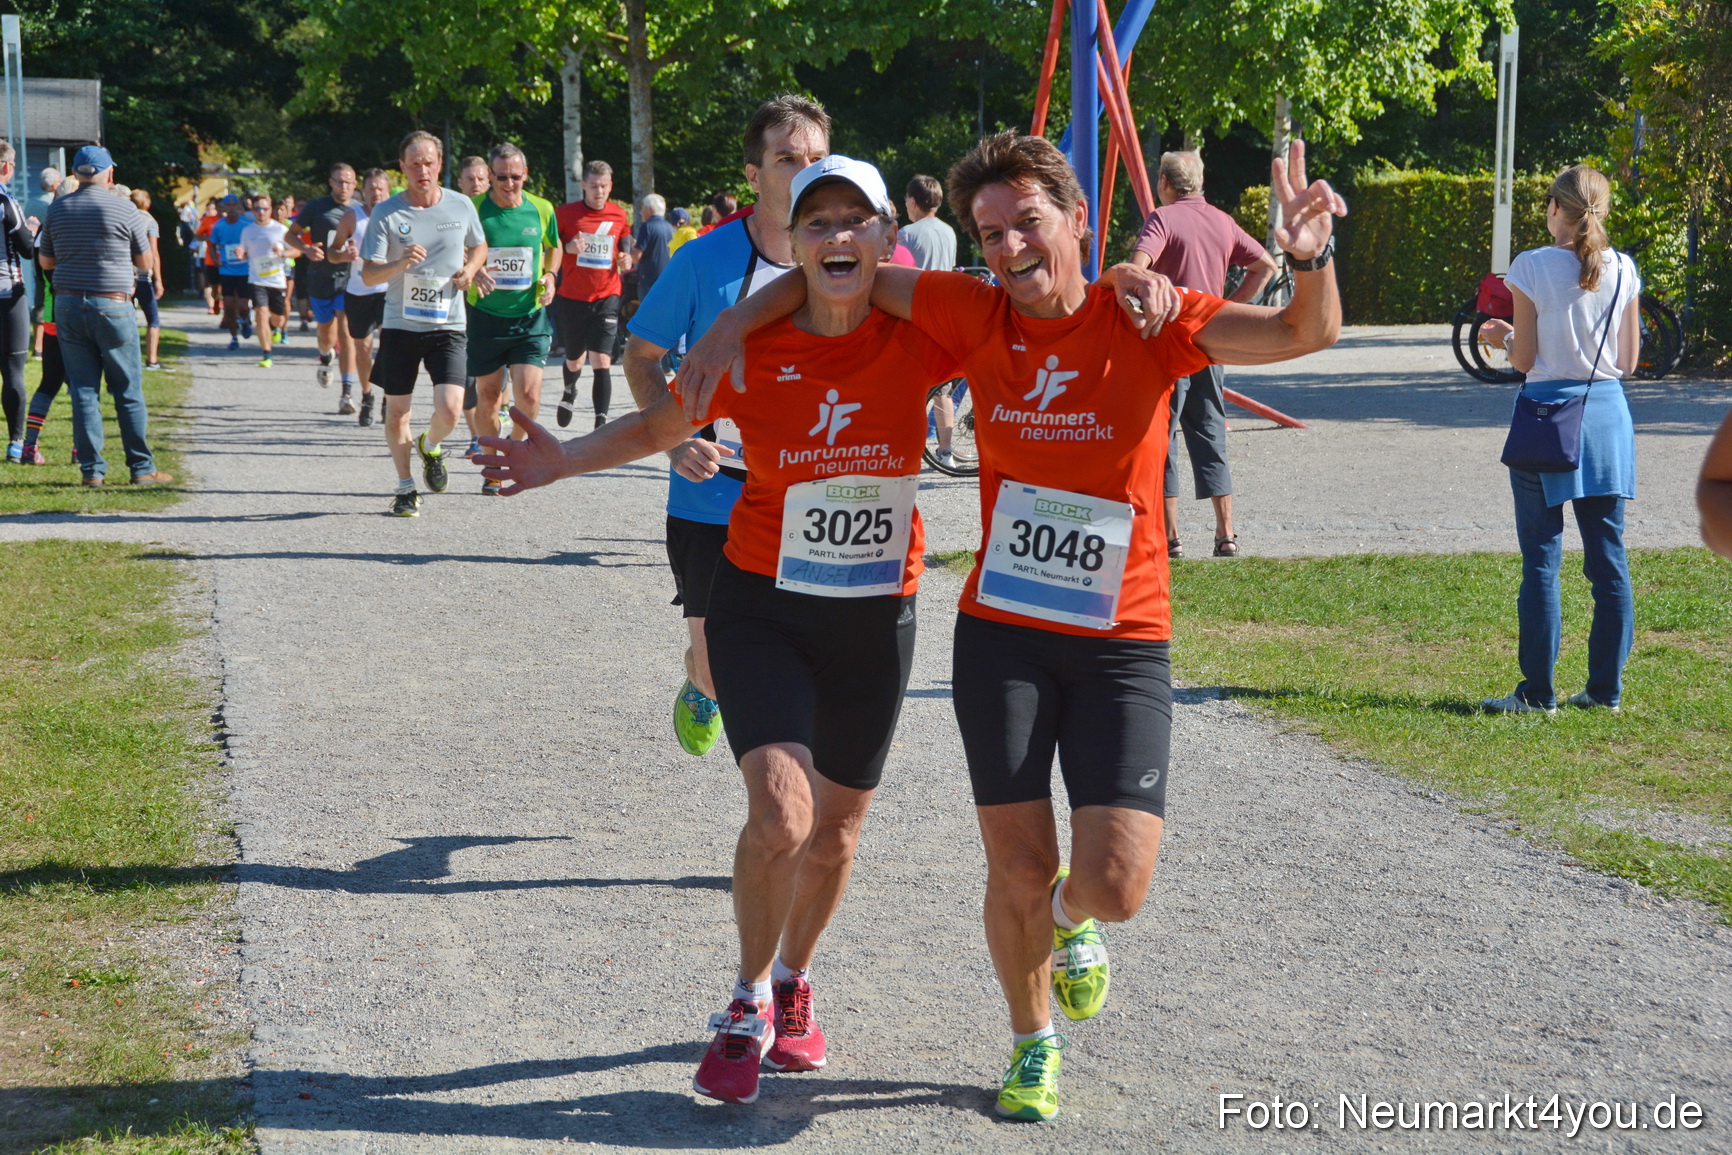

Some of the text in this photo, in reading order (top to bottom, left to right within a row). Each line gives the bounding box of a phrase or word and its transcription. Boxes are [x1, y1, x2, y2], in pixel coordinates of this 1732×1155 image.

[584, 243, 609, 255] 2619
[494, 259, 526, 272] 2567
[411, 287, 444, 304] 2521
[776, 373, 802, 382] erima
[989, 403, 1096, 426] funrunners
[1020, 424, 1115, 441] neumarkt
[778, 444, 889, 469] funrunners
[814, 455, 905, 475] neumarkt
[826, 484, 881, 499] BOCK
[1034, 498, 1093, 521] BOCK
[803, 507, 893, 546] 3025
[808, 548, 874, 560] PARTL Neumarkt
[1009, 519, 1106, 572] 3048
[792, 560, 889, 584] ANGELIKA
[1012, 563, 1080, 584] PARTL Neumarkt
